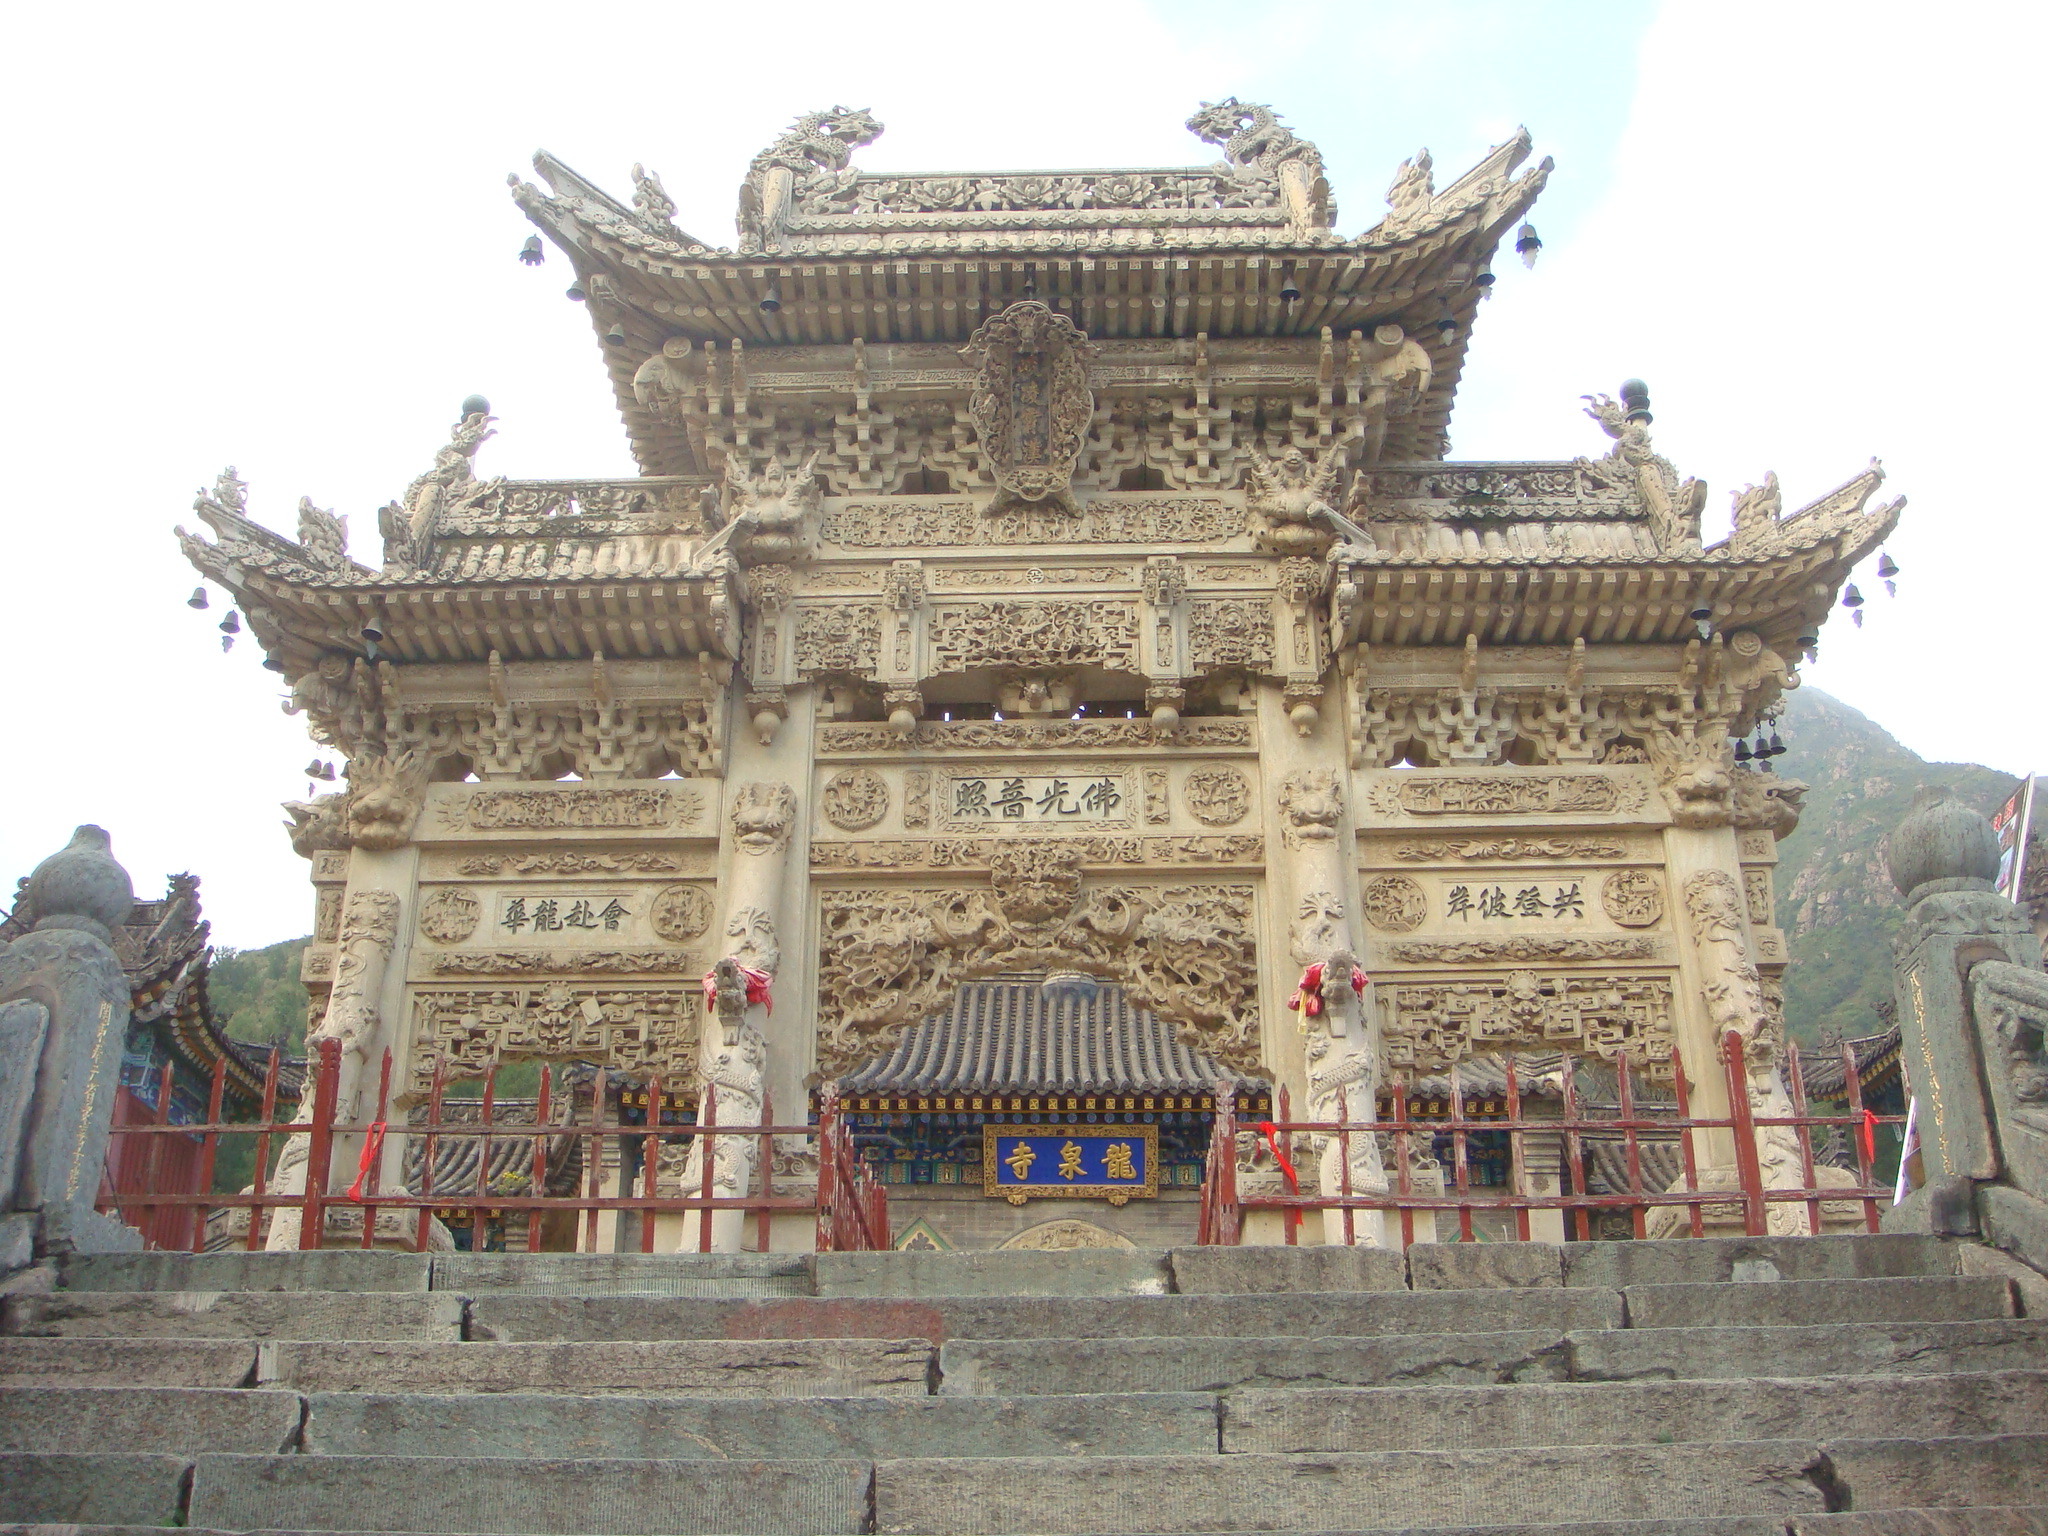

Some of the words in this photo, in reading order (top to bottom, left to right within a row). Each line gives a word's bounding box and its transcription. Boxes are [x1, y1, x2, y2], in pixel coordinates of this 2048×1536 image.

[953, 777, 1122, 819] 佛光普照
[1446, 883, 1585, 923] 共登彼岸
[1004, 1140, 1137, 1181] 龍泉寺
